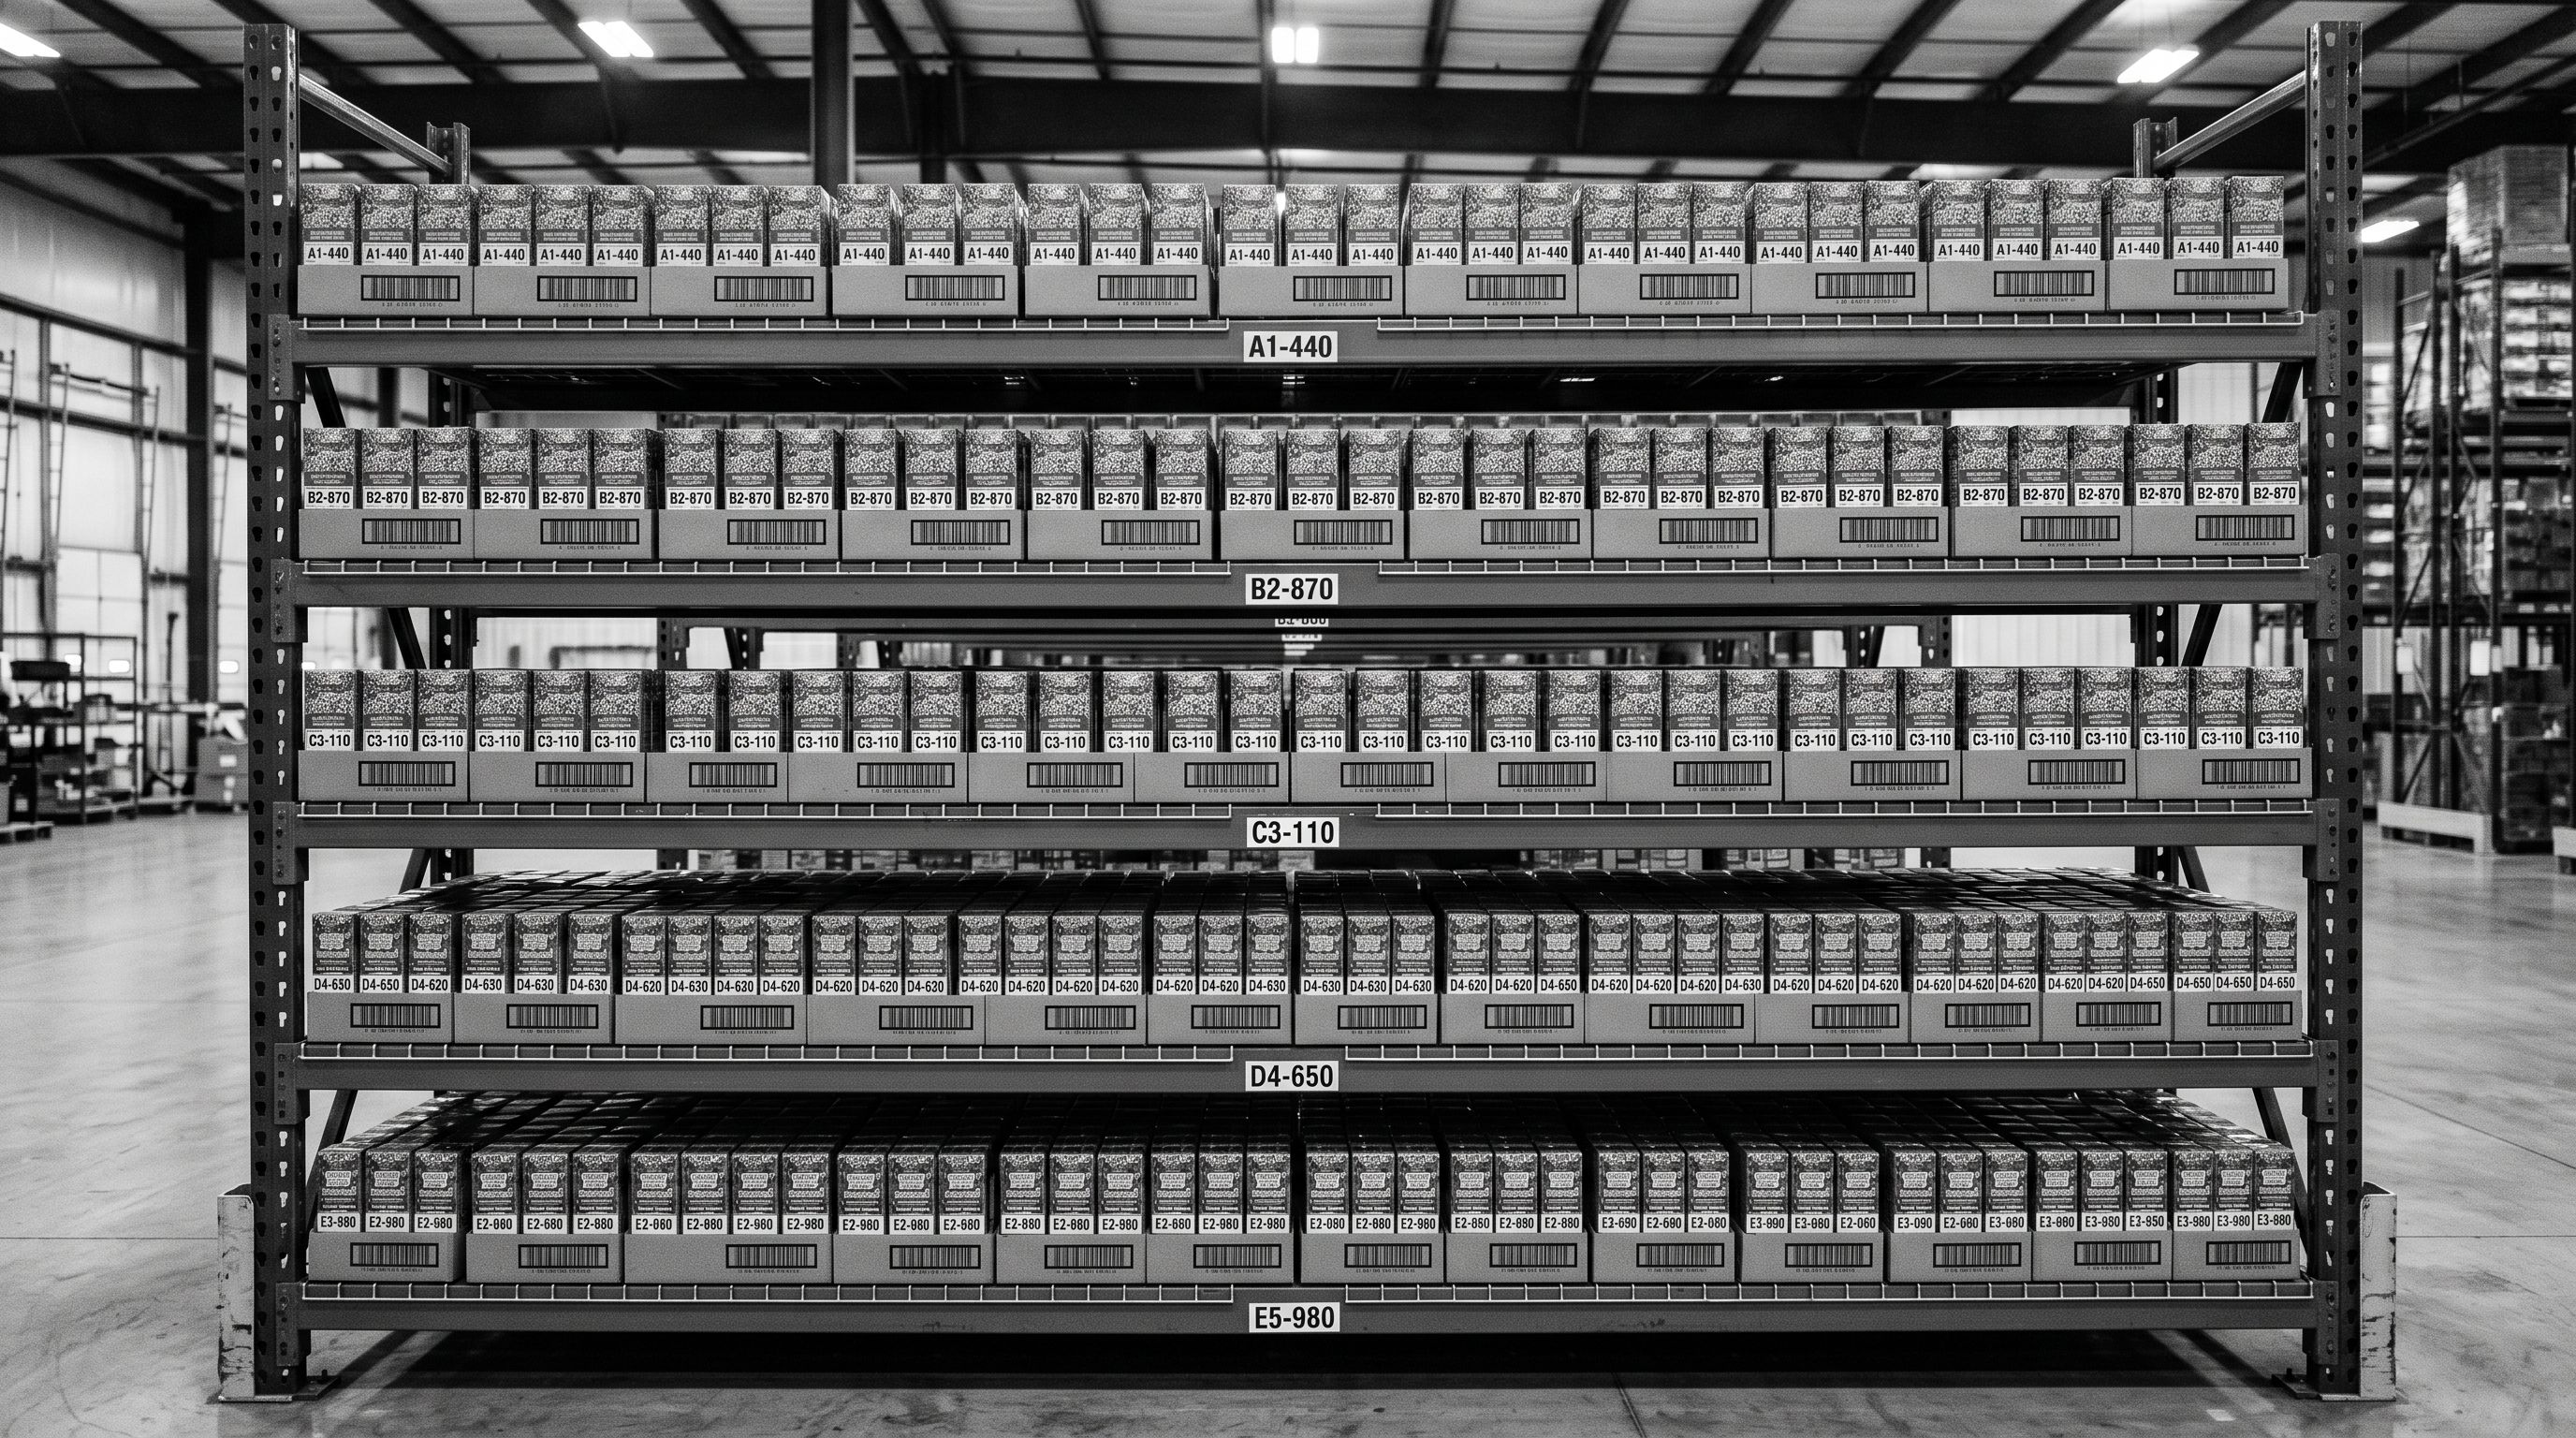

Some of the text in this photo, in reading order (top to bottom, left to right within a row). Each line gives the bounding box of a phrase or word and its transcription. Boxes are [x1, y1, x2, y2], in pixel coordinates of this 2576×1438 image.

[307, 246, 349, 259] A1-440
[366, 247, 408, 260] A1-440
[843, 247, 886, 260] A1-440
[909, 247, 951, 259] A1-440
[967, 246, 1009, 259] A1-440
[1033, 247, 1076, 260] A1-440
[1095, 247, 1136, 259] A1-440
[1157, 247, 1198, 259] A1-440
[1416, 247, 1457, 259] A1-440
[1472, 246, 1514, 259] A1-440
[1527, 245, 1568, 258] A1-440
[1588, 246, 1630, 259] A1-440
[1644, 246, 1686, 258] A1-440
[1699, 245, 1741, 258] A1-440
[1761, 246, 1803, 259] A1-440
[1816, 245, 1858, 257] A1-440
[1873, 243, 1915, 257] A1-440
[1938, 243, 1981, 257] A1-440
[1997, 242, 2039, 256] A1-440
[2055, 242, 2097, 256] A1-440
[2117, 242, 2160, 255] A1-440
[2177, 241, 2220, 254] A1-440
[2236, 240, 2279, 254] A1-440
[422, 248, 464, 261] A1-440
[483, 248, 525, 261] A1-440
[540, 248, 582, 261] A1-440
[596, 248, 638, 261] A1-440
[660, 248, 702, 261] A1-440
[717, 248, 758, 261] A1-440
[774, 248, 816, 261] A1-440
[1229, 248, 1270, 261] A1-440
[1291, 248, 1333, 261] A1-440
[1352, 248, 1394, 260] A1-440
[1248, 334, 1333, 360] A1-440
[308, 491, 350, 505] B2-870
[366, 491, 408, 505] B2-870
[422, 491, 464, 505] B2-870
[484, 491, 526, 505] B2-870
[542, 492, 584, 505] B2-870
[599, 492, 641, 505] B2-870
[670, 492, 711, 505] B2-870
[729, 492, 771, 505] B2-870
[787, 492, 829, 505] B2-870
[850, 492, 892, 505] B2-870
[910, 492, 952, 505] B2-870
[970, 492, 1012, 506] B2-870
[1035, 492, 1077, 506] B2-870
[1098, 492, 1140, 505] B2-870
[1161, 492, 1202, 505] B2-870
[1230, 492, 1272, 506] B2-870
[1292, 492, 1333, 506] B2-870
[1353, 492, 1395, 505] B2-870
[1418, 492, 1460, 505] B2-870
[1479, 492, 1521, 505] B2-870
[1539, 491, 1581, 504] B2-870
[1603, 491, 1646, 504] B2-870
[1661, 490, 1703, 504] B2-870
[1718, 490, 1760, 504] B2-870
[1780, 489, 1823, 503] B2-870
[1838, 489, 1881, 502] B2-870
[1896, 489, 1939, 502] B2-870
[1963, 488, 2005, 501] B2-870
[2023, 488, 2065, 501] B2-870
[2078, 488, 2120, 501] B2-870
[2139, 487, 2182, 500] B2-870
[2197, 487, 2239, 500] B2-870
[2253, 486, 2296, 500] B2-870
[1251, 577, 1334, 601] B2-870
[309, 734, 351, 747] C3-110
[367, 734, 409, 747] C3-110
[421, 734, 463, 748] C3-110
[478, 734, 520, 748] C3-110
[537, 734, 579, 748] C3-110
[594, 735, 637, 748] C3-110
[669, 735, 711, 749] C3-110
[734, 735, 776, 749] C3-110
[798, 735, 839, 749] C3-110
[857, 736, 899, 749] C3-110
[915, 736, 957, 749] C3-110
[981, 736, 1022, 749] C3-110
[1045, 736, 1086, 749] C3-110
[1108, 736, 1149, 749] C3-110
[1172, 736, 1213, 749] C3-110
[1235, 735, 1277, 749] C3-110
[1300, 735, 1342, 749] C3-110
[1363, 735, 1404, 749] C3-110
[1426, 735, 1467, 749] C3-110
[1490, 735, 1532, 749] C3-110
[1554, 735, 1596, 748] C3-110
[1616, 734, 1658, 748] C3-110
[1675, 734, 1716, 748] C3-110
[1732, 734, 1774, 747] C3-110
[1794, 733, 1836, 747] C3-110
[1851, 733, 1893, 747] C3-110
[1910, 733, 1951, 746] C3-110
[1972, 732, 2014, 746] C3-110
[2028, 732, 2071, 746] C3-110
[2085, 732, 2128, 745] C3-110
[2144, 731, 2186, 745] C3-110
[2201, 731, 2243, 745] C3-110
[2258, 731, 2300, 744] C3-110
[1251, 820, 1336, 845] C3-110
[314, 977, 351, 990] D4-650
[362, 977, 400, 991] D4-650
[411, 978, 448, 991] D4-620
[465, 978, 503, 991] D4-630
[517, 978, 554, 991] D4-630
[570, 978, 607, 991] D4-630
[763, 979, 800, 992] D4-620
[815, 979, 853, 992] D4-620
[1156, 979, 1193, 992] D4-620
[1202, 979, 1239, 992] D4-620
[1249, 979, 1286, 992] D4-630
[1450, 978, 1487, 991] D4-620
[1495, 978, 1532, 991] D4-620
[1541, 978, 1577, 991] D4-650
[1591, 978, 1629, 991] D4-620
[1680, 978, 1717, 991] D4-620
[1724, 978, 1762, 991] D4-630
[1773, 978, 1810, 991] D4-620
[2048, 977, 2083, 990] D4-620
[2130, 976, 2165, 990] D4-650
[2176, 976, 2212, 990] D4-650
[2216, 976, 2252, 989] D4-650
[2260, 976, 2295, 989] D4-650
[1251, 1064, 1335, 1089] D4-650
[369, 1215, 405, 1228] E2-980
[527, 1217, 564, 1230] E2-680
[577, 1217, 614, 1230] E2-880
[787, 1217, 825, 1230] E2-980
[842, 1218, 880, 1231] E2-980
[1004, 1217, 1041, 1230] E2-880
[1250, 1217, 1286, 1230] E2-980
[1400, 1217, 1436, 1230] E2-980
[1544, 1216, 1580, 1229] E2-880
[1897, 1216, 1933, 1229] E3-090
[2085, 1215, 2120, 1228] E3-980
[2176, 1215, 2211, 1227] E3-980
[2217, 1214, 2251, 1227] E3-980
[1255, 1305, 1336, 1330] E5-980
